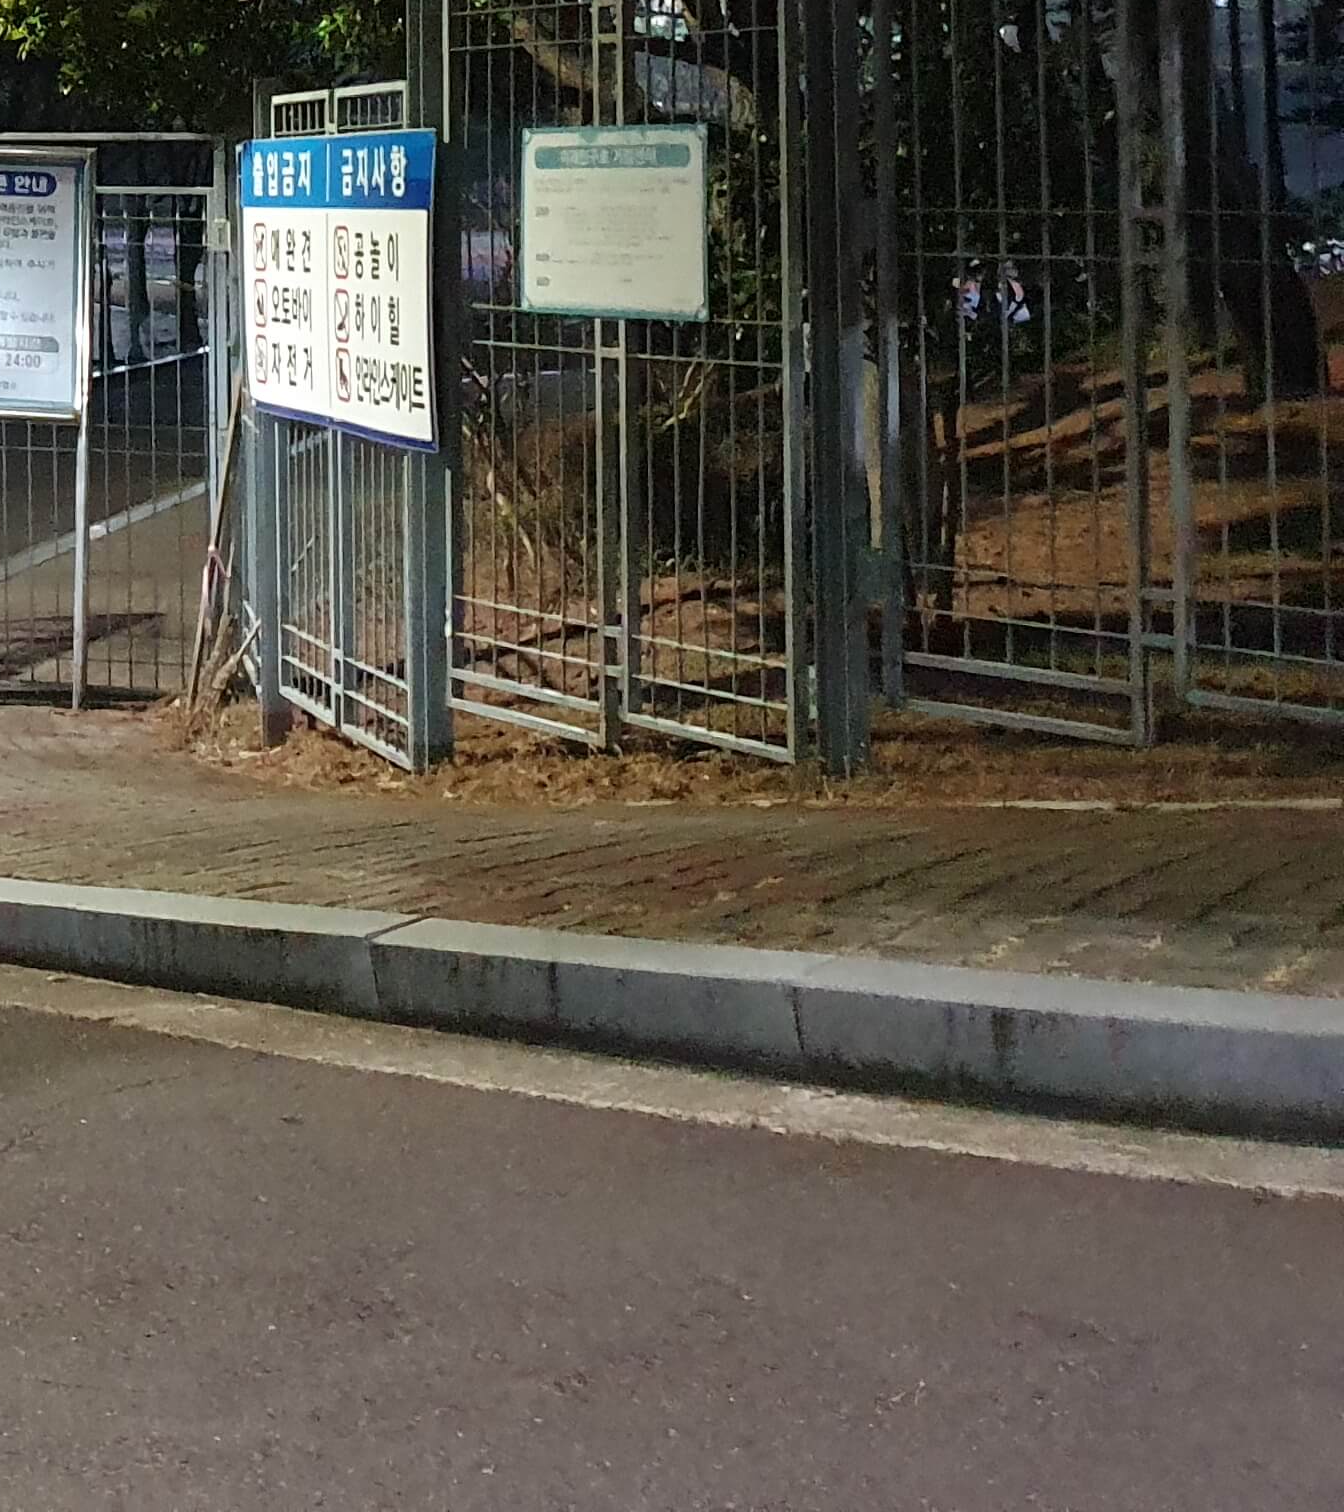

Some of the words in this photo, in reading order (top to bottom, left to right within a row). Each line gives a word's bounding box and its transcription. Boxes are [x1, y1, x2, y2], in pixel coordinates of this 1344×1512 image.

[14, 175, 48, 194] 안내
[253, 150, 311, 197] 출입금지
[341, 144, 407, 197] 금지사항
[271, 228, 311, 273] 애완견
[354, 231, 399, 281] 공놀이
[271, 285, 312, 332] 오토바이
[355, 293, 400, 346] 하이힐
[5, 353, 41, 368] 24:00
[271, 342, 313, 391] 자전거
[356, 355, 425, 413] 인라인스케이트
